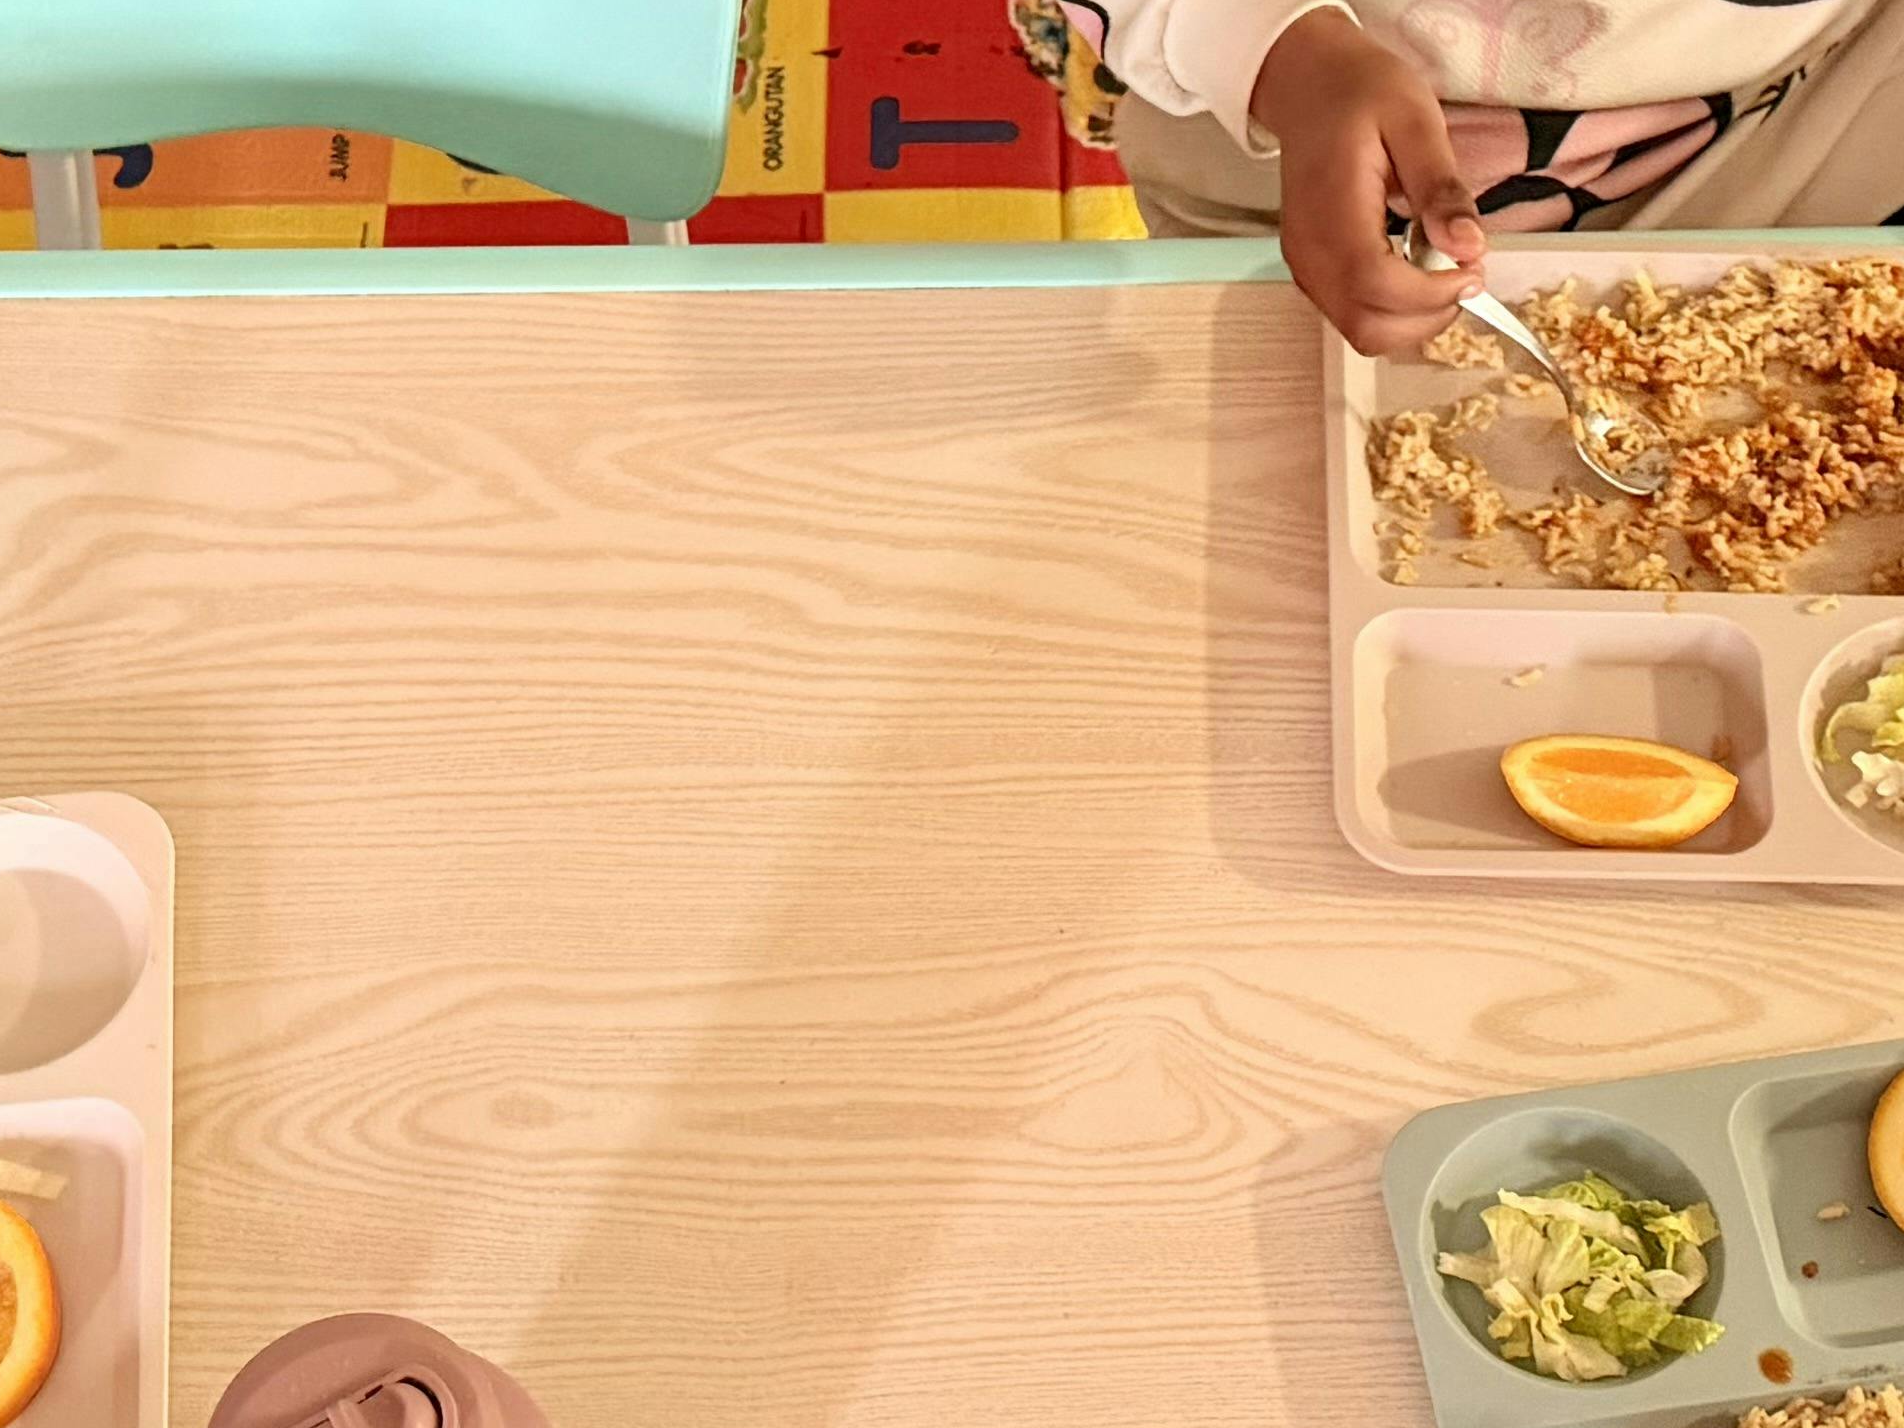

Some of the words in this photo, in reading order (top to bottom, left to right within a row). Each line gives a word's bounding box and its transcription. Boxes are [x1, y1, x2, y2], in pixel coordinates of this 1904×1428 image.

[763, 66, 785, 171] ORANGUTAN
[871, 97, 1018, 170] T
[329, 134, 350, 181] JUMP
